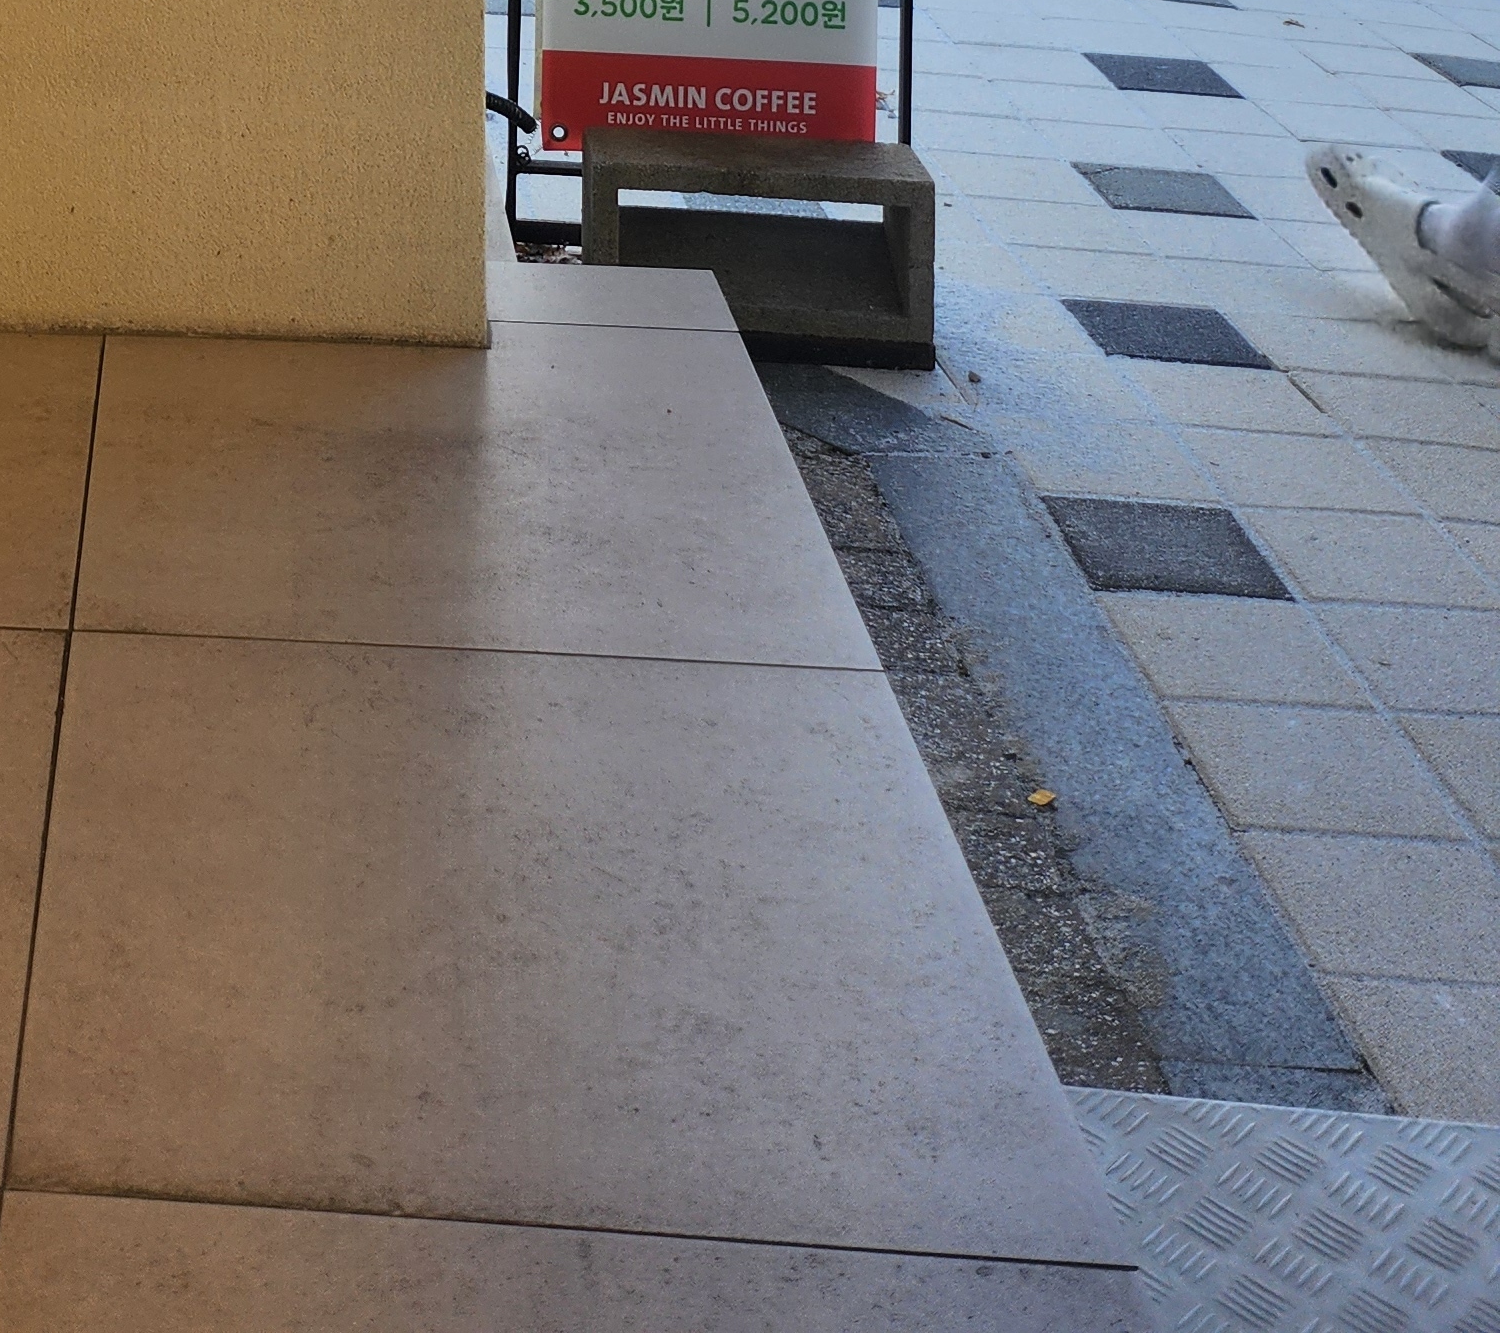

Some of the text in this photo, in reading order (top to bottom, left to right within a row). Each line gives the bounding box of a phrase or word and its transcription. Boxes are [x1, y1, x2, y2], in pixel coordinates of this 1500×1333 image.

[599, 81, 817, 115] JASMIN COFFEE
[607, 111, 808, 134] ENJOY THE LITTLE THINGS
